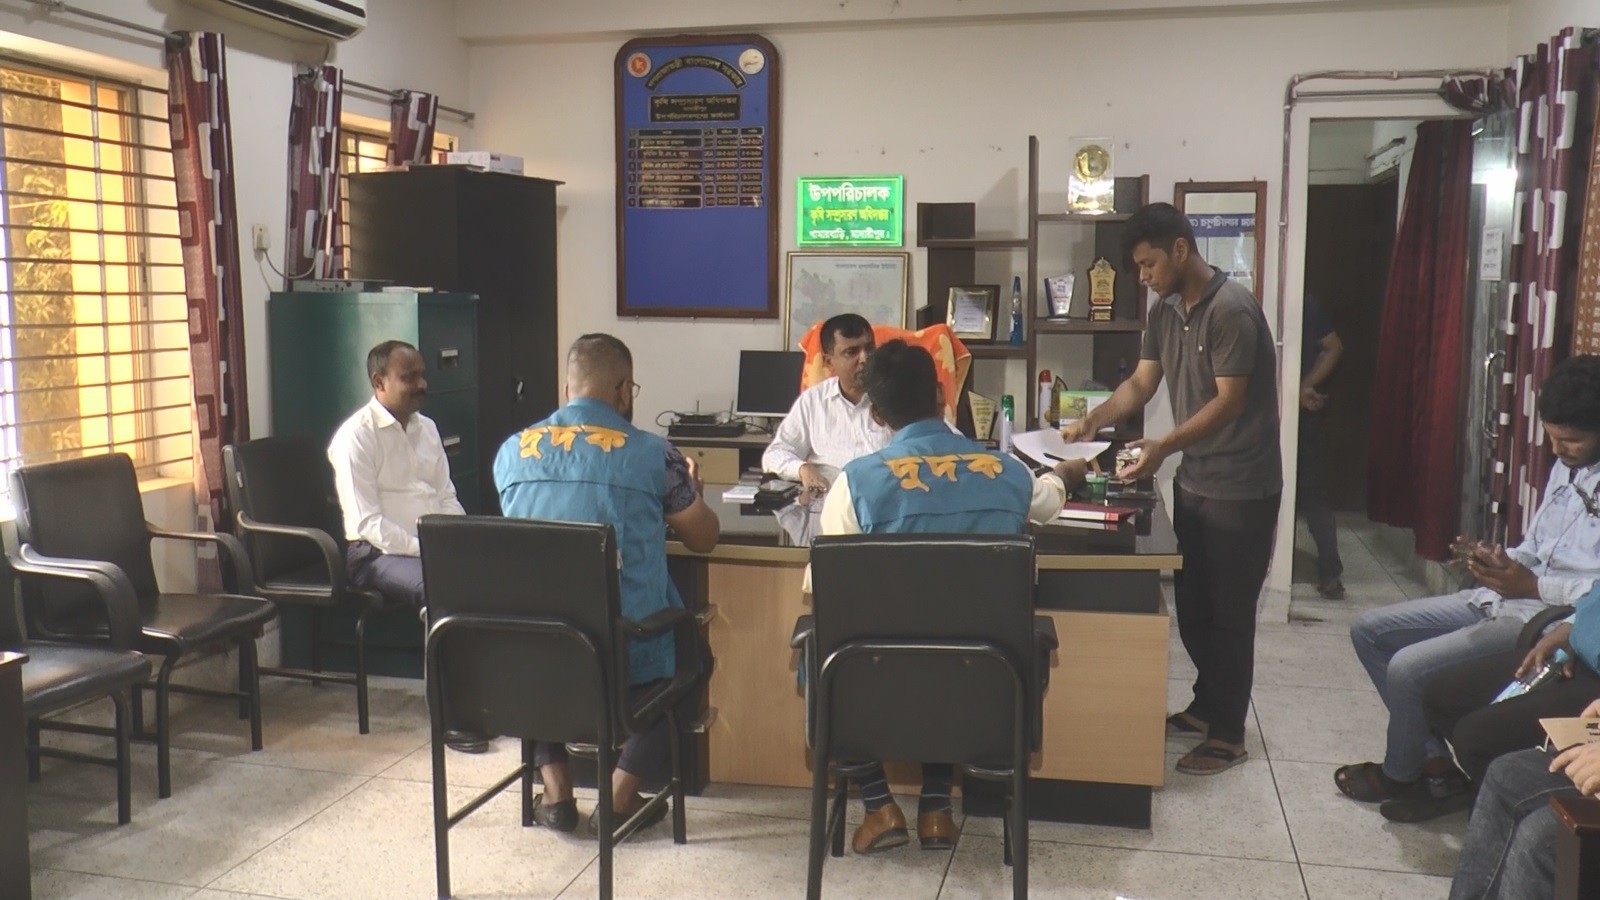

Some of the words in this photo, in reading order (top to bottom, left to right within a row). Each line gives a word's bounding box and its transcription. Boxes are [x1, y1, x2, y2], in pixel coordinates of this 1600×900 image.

[654, 96, 668, 107] কৃষি
[808, 182, 891, 202] উপপরিচালক
[810, 206, 825, 226] কৃষি
[519, 425, 629, 460] দুদক
[884, 453, 1003, 493] দুদক
